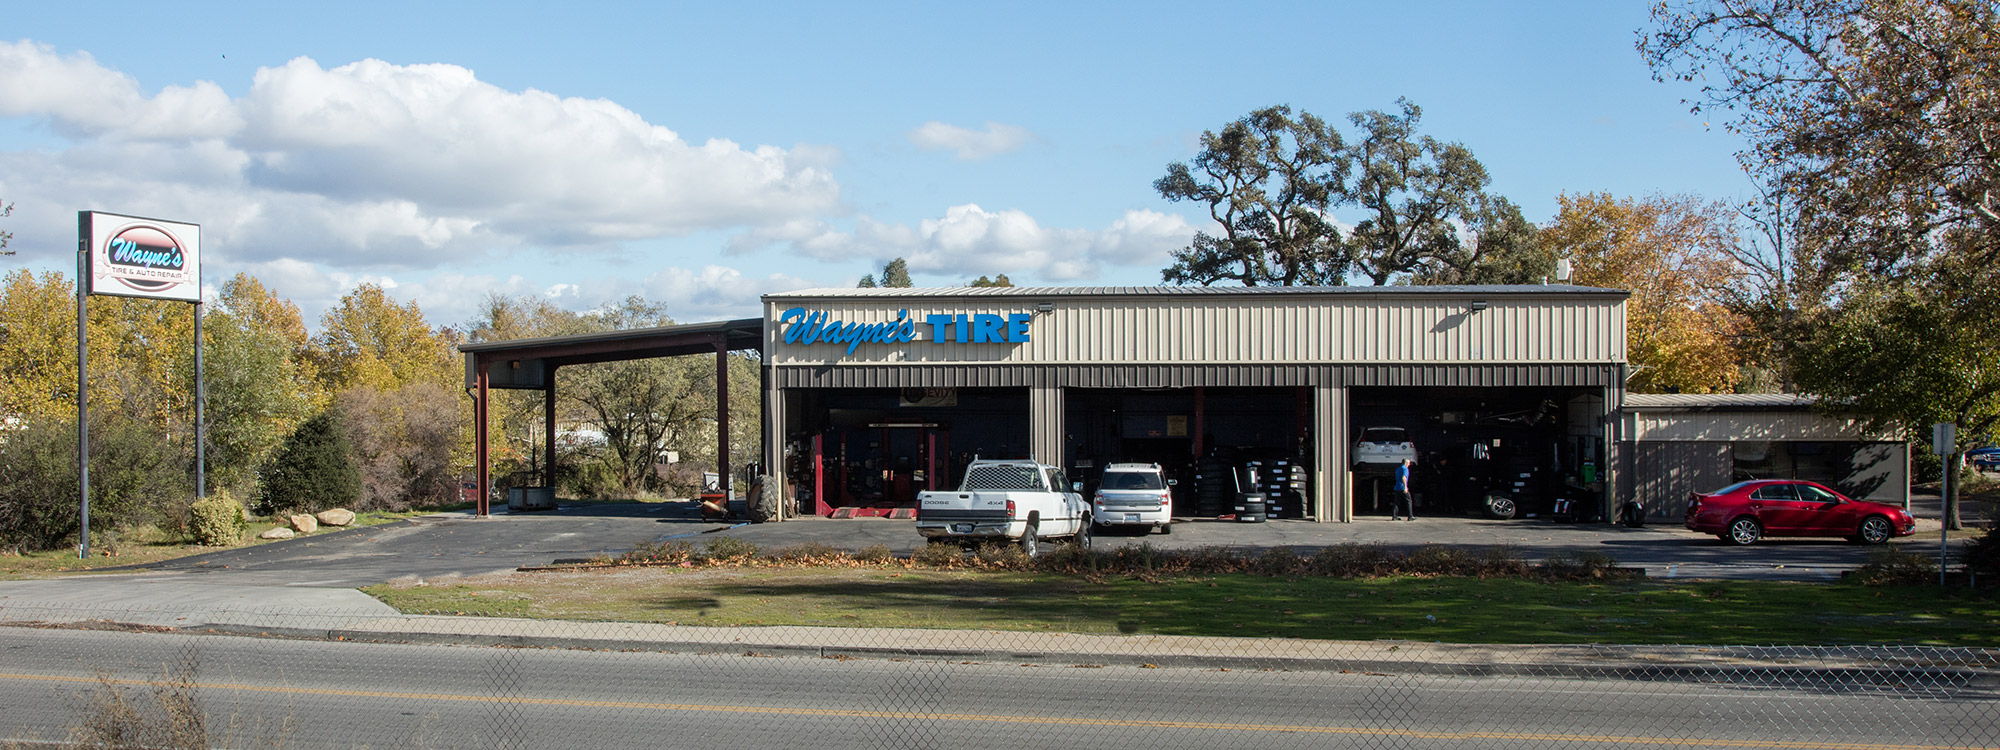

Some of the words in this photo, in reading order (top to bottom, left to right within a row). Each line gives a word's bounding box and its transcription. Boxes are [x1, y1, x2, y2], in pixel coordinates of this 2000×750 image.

[111, 237, 183, 269] Wayne's
[112, 266, 127, 275] TIRE
[136, 269, 156, 277] AUTO
[157, 271, 182, 279] REPAIR
[780, 307, 917, 356] Wayne's
[926, 313, 1030, 344] TIRE
